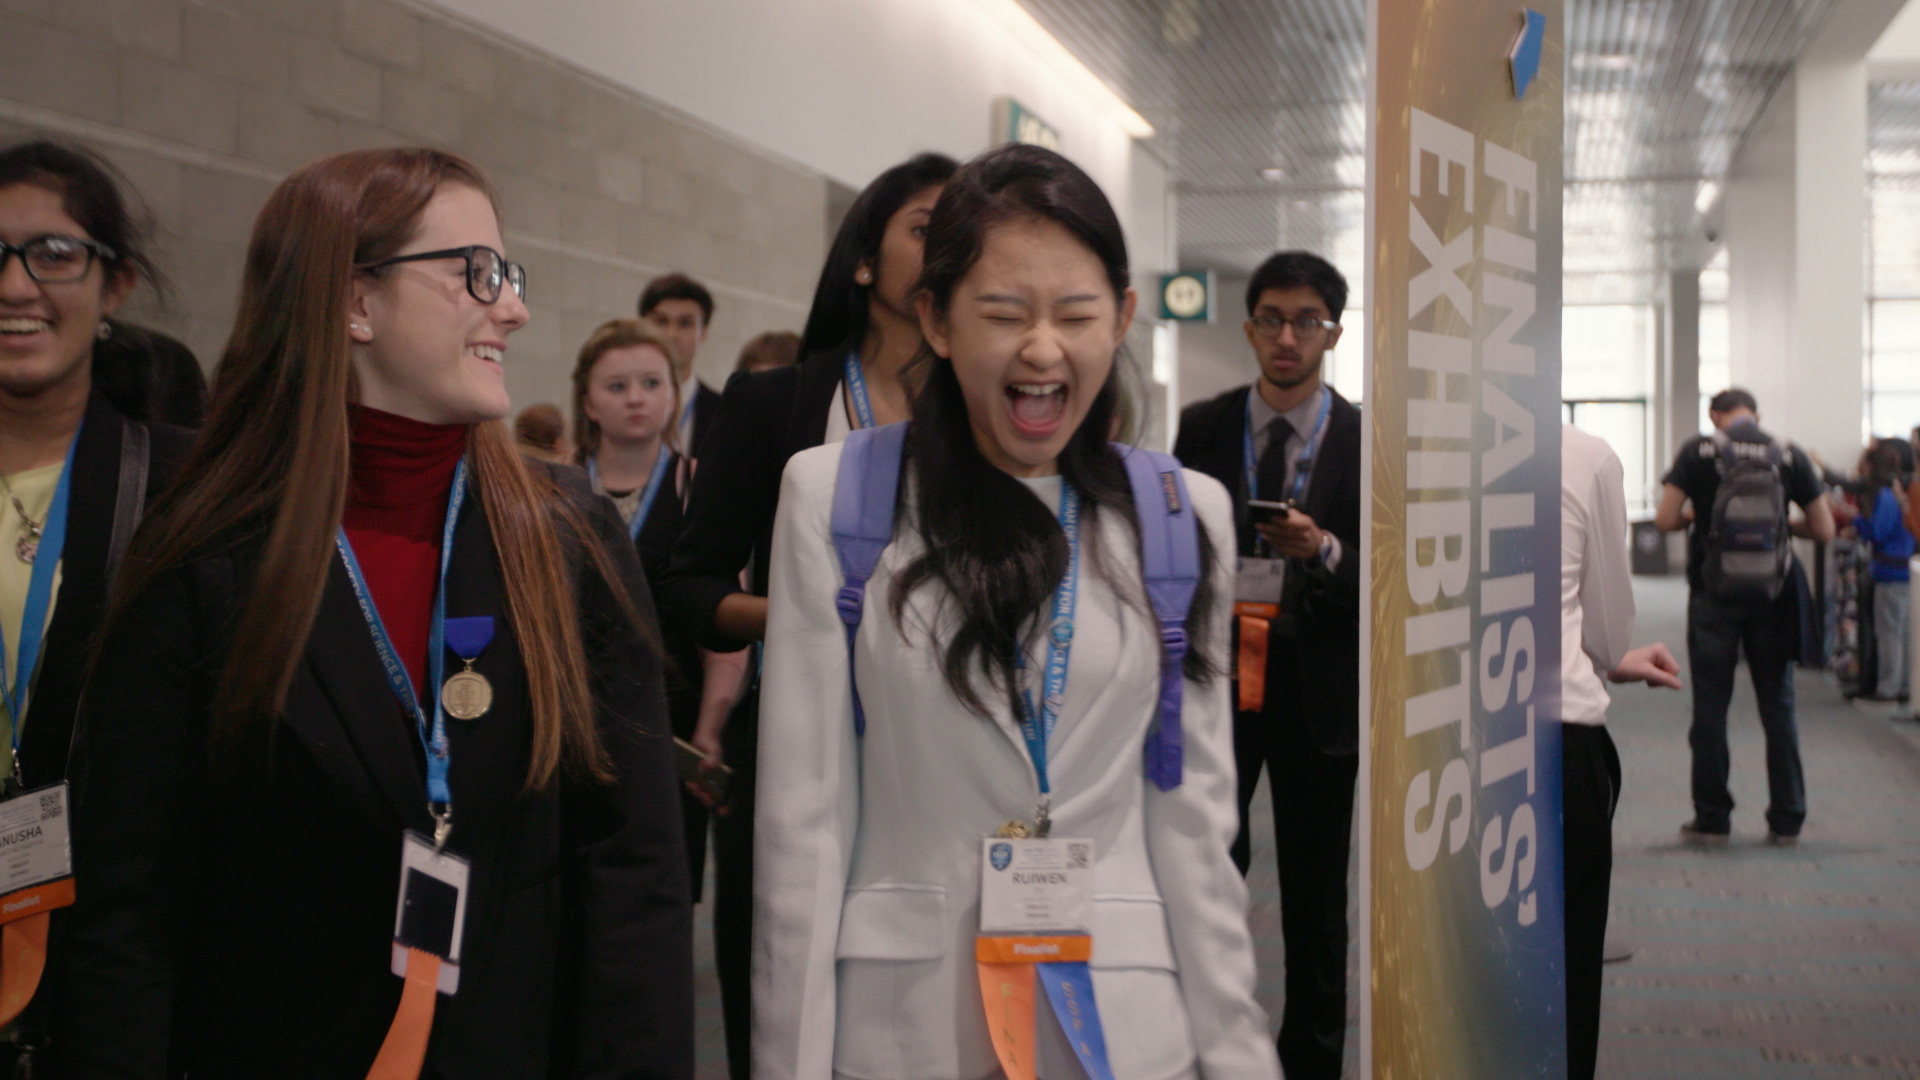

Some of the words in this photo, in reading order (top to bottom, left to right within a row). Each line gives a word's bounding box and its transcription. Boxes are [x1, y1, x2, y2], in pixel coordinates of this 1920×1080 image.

[1403, 106, 1475, 873] EXHIBITS
[1479, 138, 1538, 928] FINALISTS'
[370, 623, 398, 676] SCIENCE
[0, 825, 43, 848] NUSHA
[1012, 872, 1068, 884] RUIWEN
